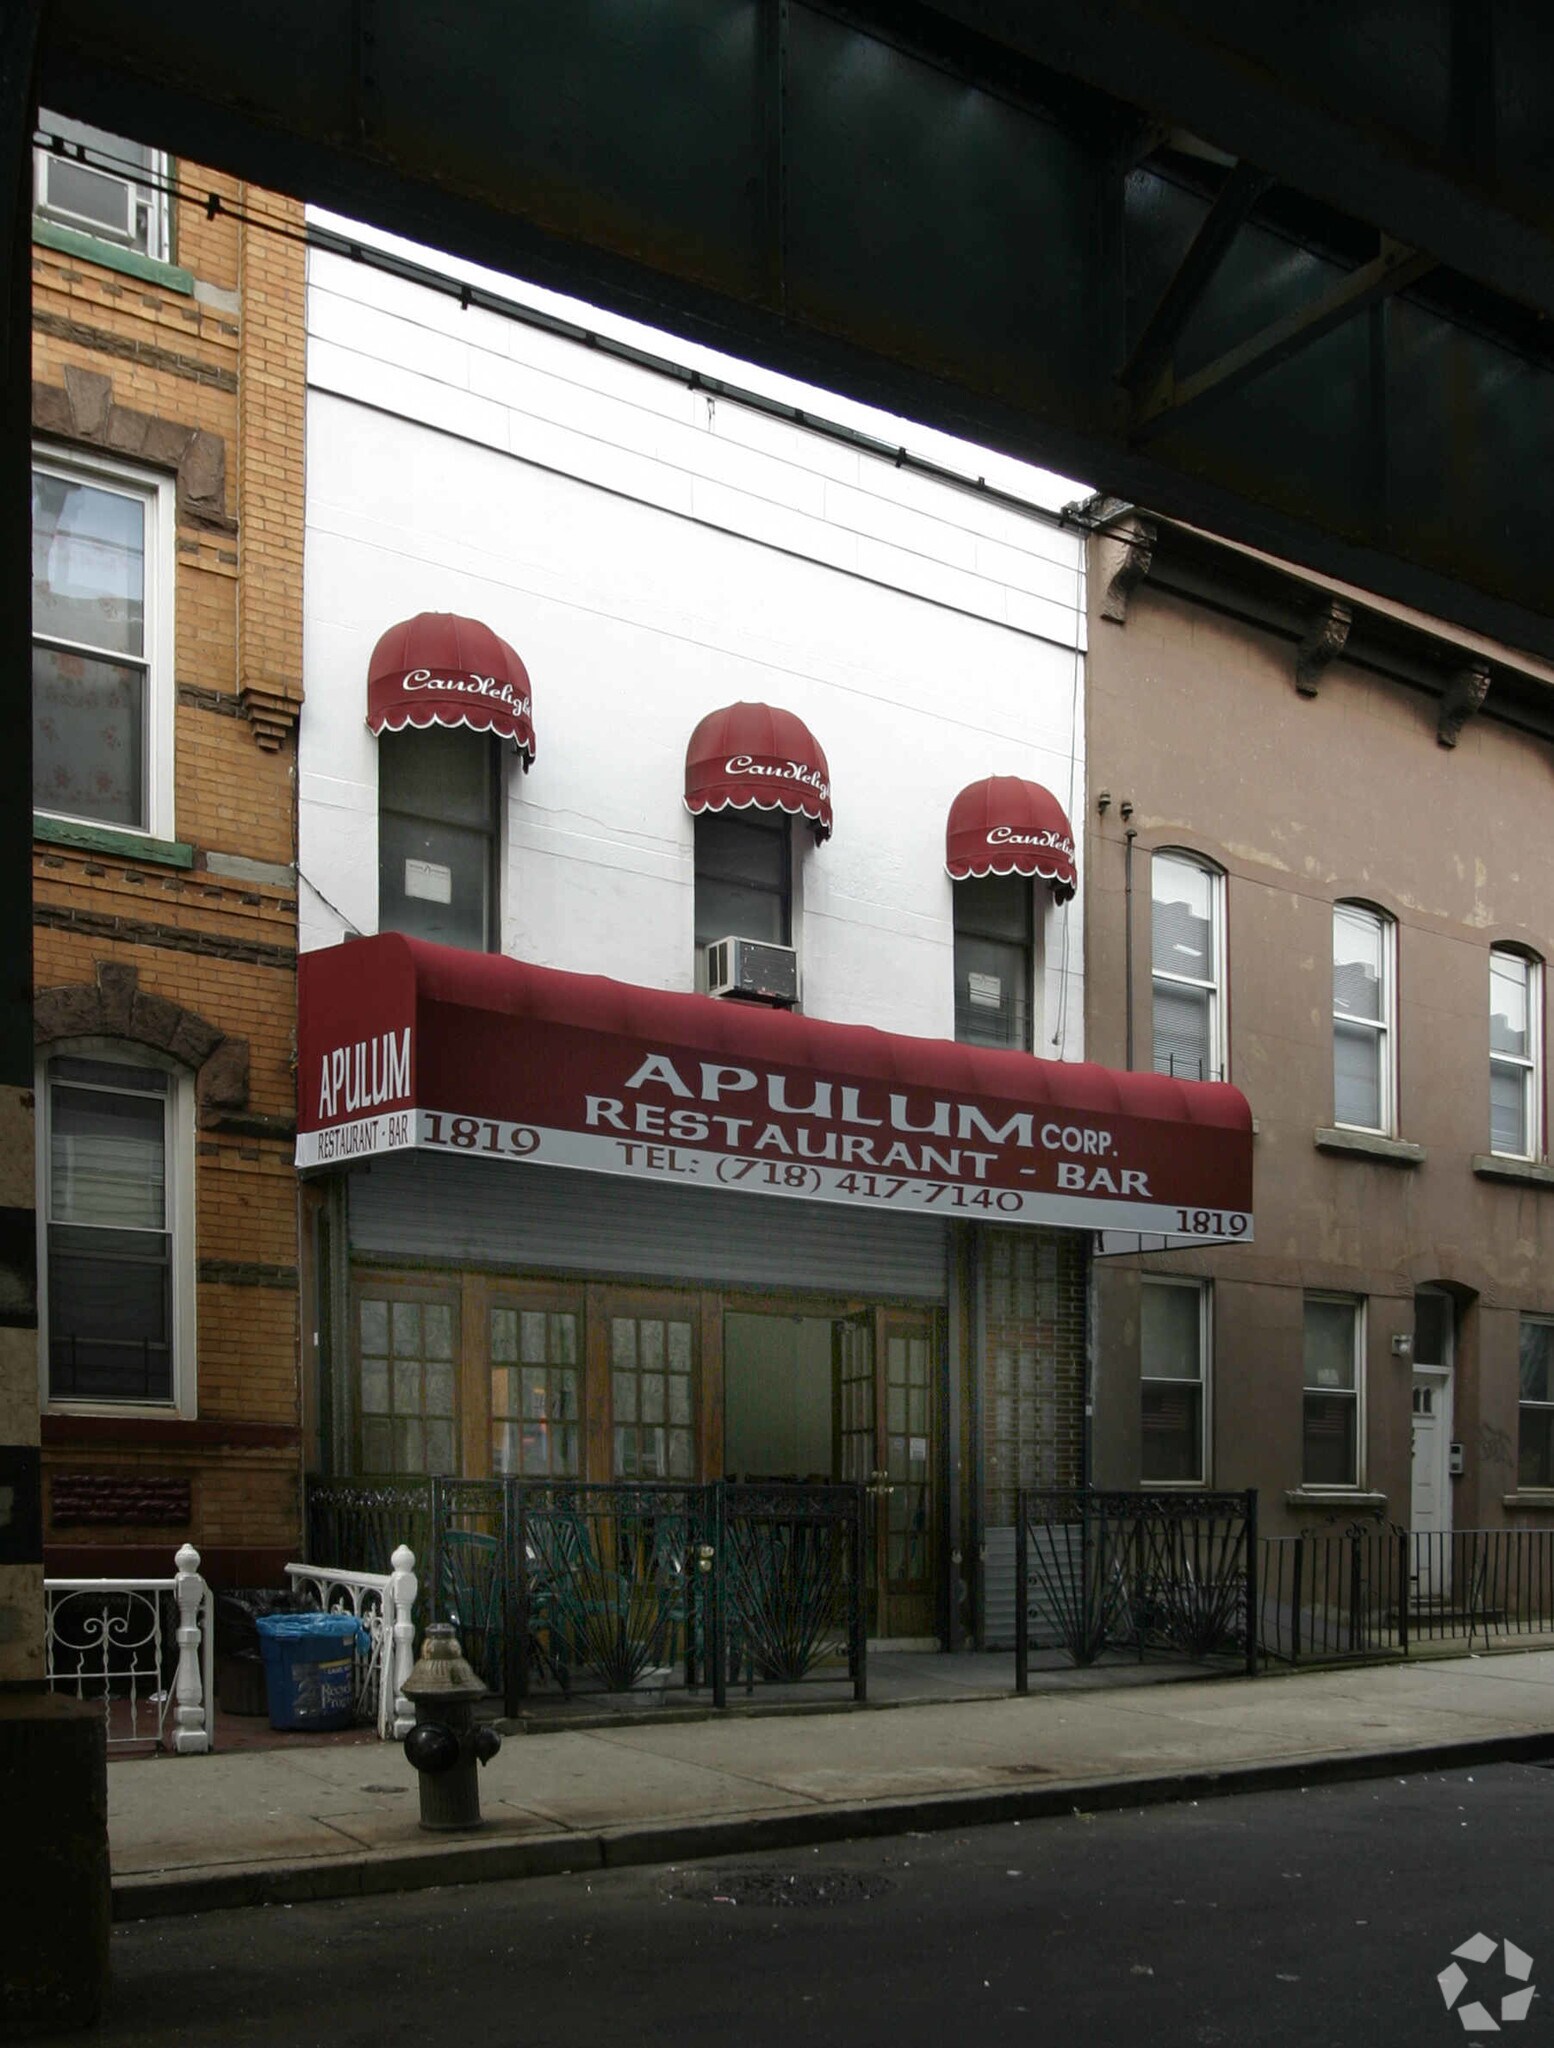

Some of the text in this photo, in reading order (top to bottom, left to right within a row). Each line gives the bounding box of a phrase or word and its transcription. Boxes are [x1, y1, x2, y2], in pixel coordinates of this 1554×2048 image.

[318, 1026, 411, 1119] APULUM
[624, 1053, 1118, 1157] APULUM CORP.
[318, 1120, 379, 1160] RESTAURANT
[388, 1114, 408, 1147] BAR
[424, 1112, 541, 1156] 1819
[585, 1095, 998, 1179] RESTAURANT
[1057, 1162, 1153, 1197] BAR
[716, 1157, 821, 1193] (718)
[834, 1173, 1024, 1211] 417-7140
[1176, 1209, 1247, 1236] 1819
